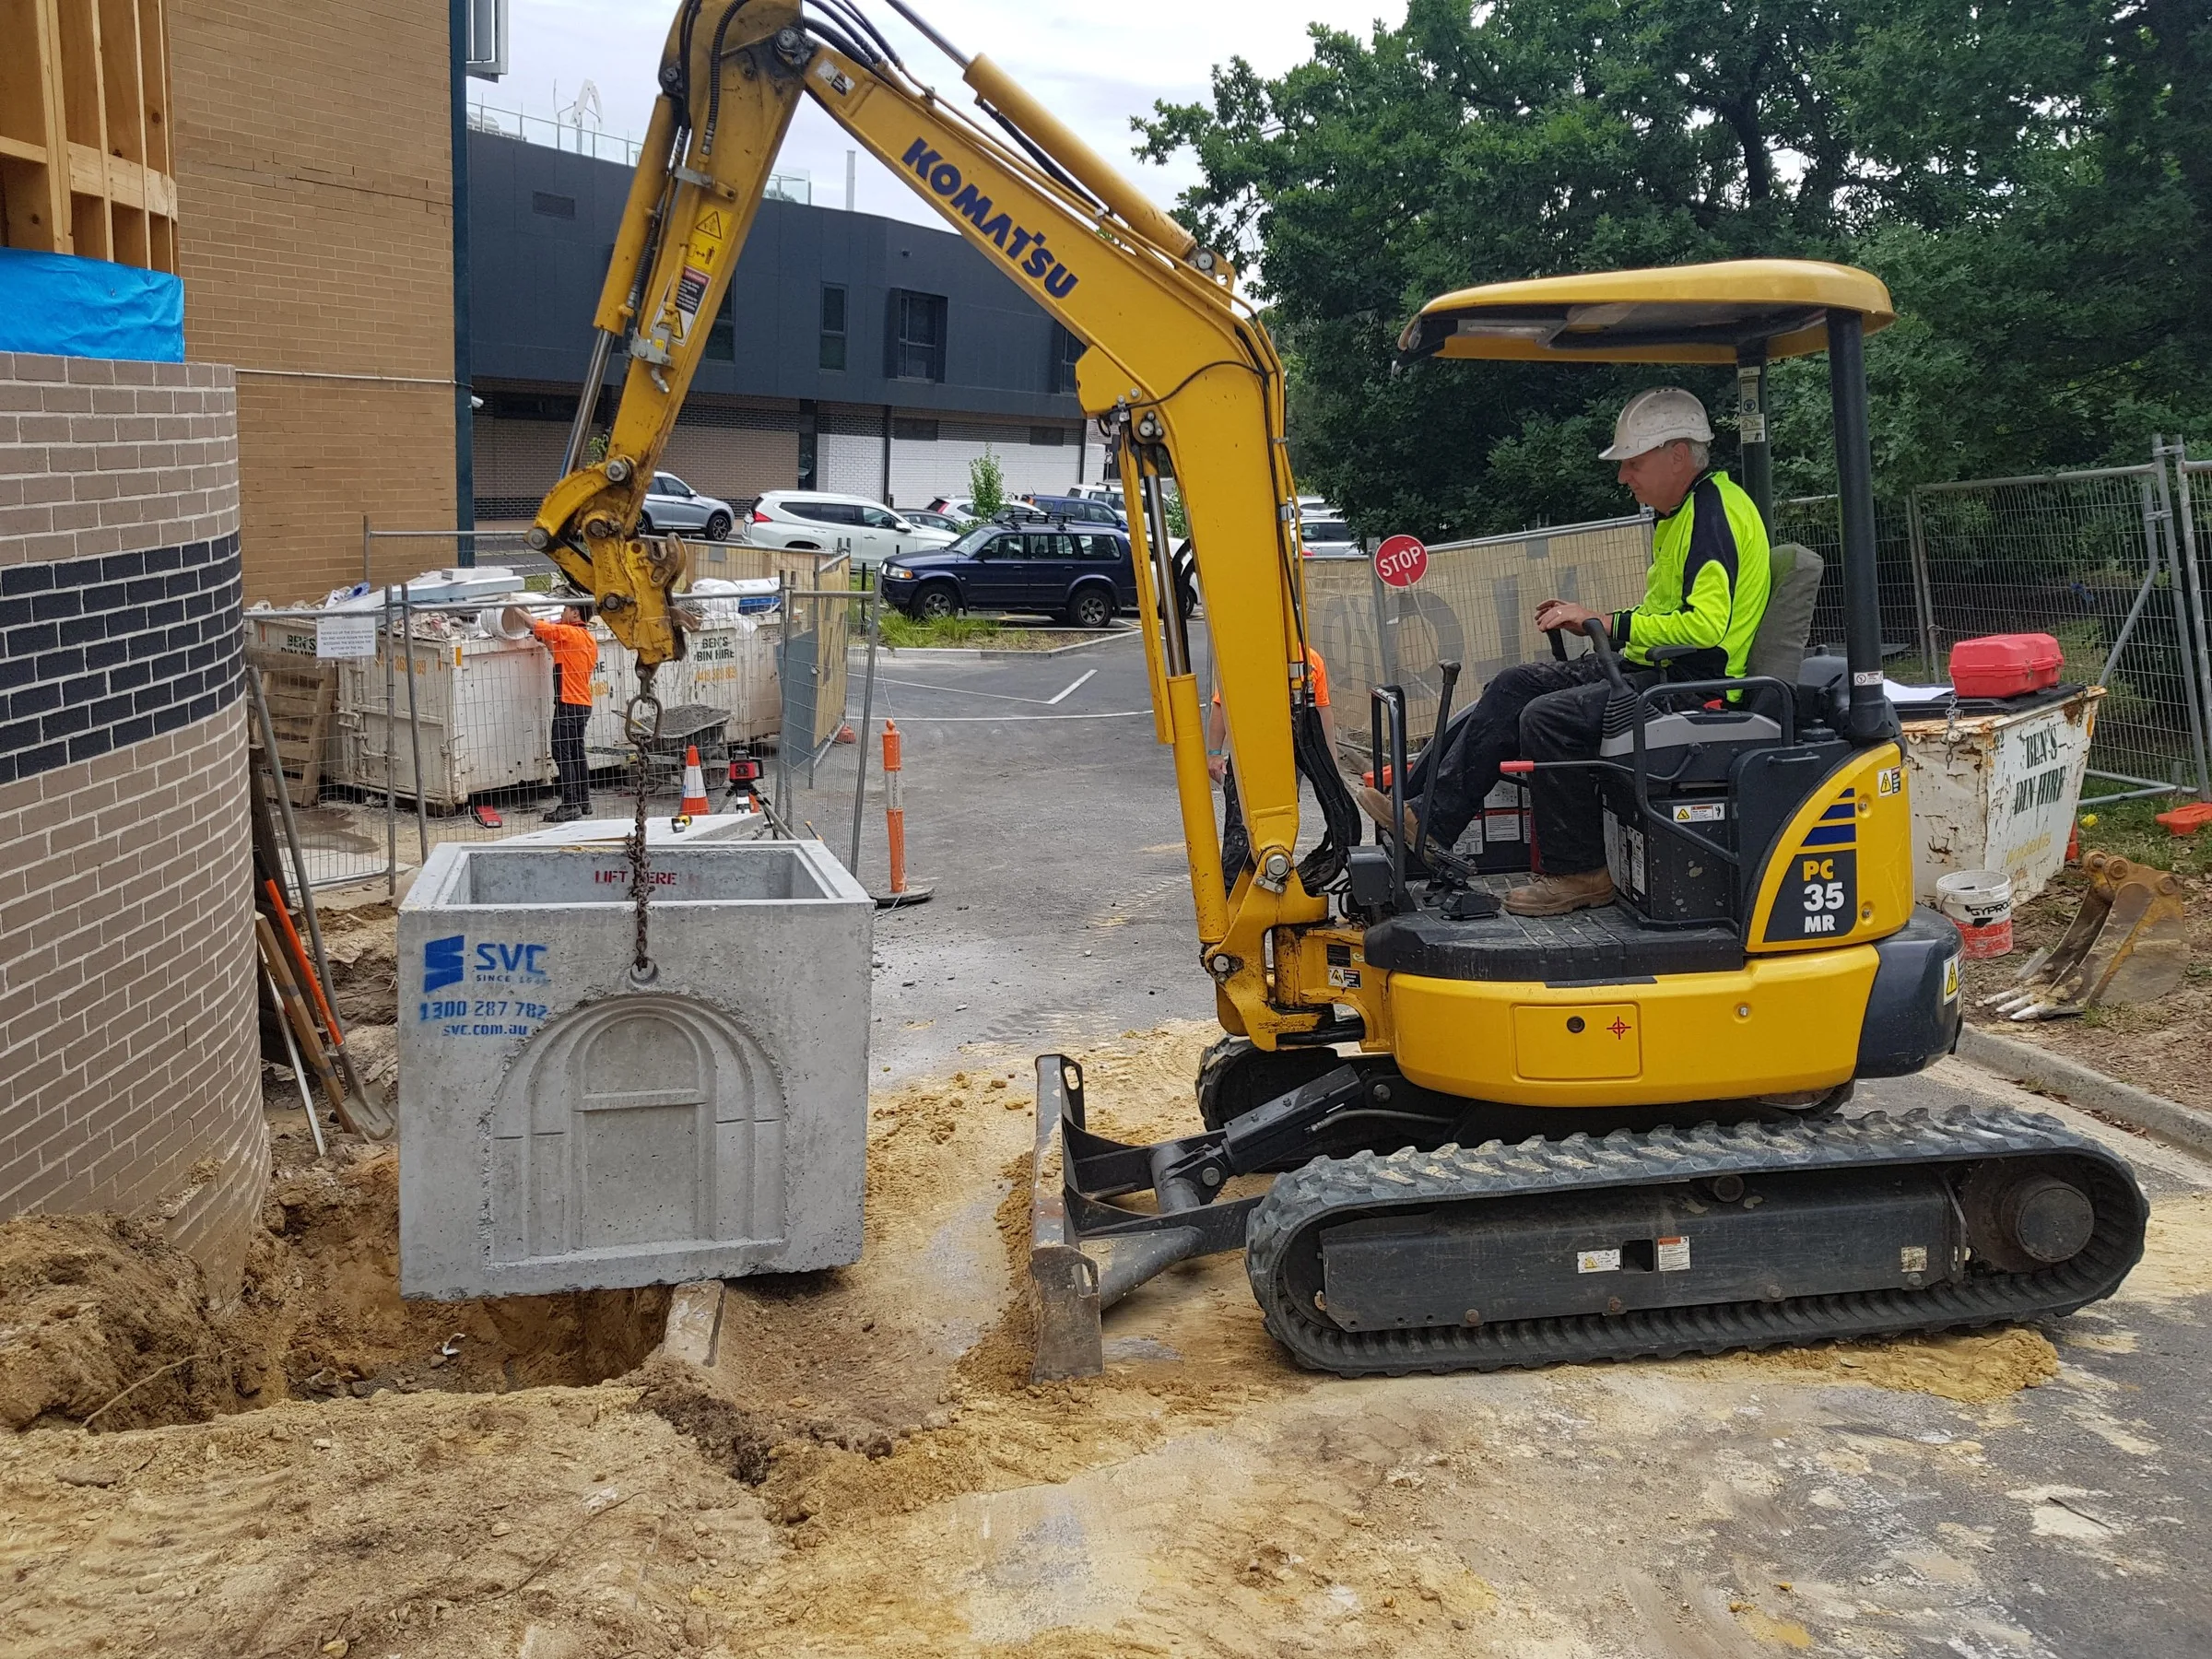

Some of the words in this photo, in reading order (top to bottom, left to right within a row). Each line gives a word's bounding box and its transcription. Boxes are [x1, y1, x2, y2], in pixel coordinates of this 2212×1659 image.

[901, 136, 1079, 299] KOMATSU
[1380, 546, 1421, 577] STOP
[702, 636, 729, 649] BEN'S
[697, 650, 712, 662] BIN
[715, 648, 735, 660] HIRE
[2025, 728, 2058, 769] BEN'S
[2013, 776, 2036, 815] BIN
[2036, 765, 2067, 806] HIRE
[594, 870, 629, 883] LIFT
[645, 871, 677, 886] ERE
[1803, 858, 1834, 881] PC
[1803, 882, 1845, 912] 35
[1970, 901, 2011, 916] GYPRO
[1804, 914, 1836, 933] MR
[474, 943, 547, 975] SVC
[476, 974, 512, 982] SINCE
[419, 1001, 467, 1021] 1300
[475, 1001, 508, 1016] 287
[515, 1001, 547, 1020] 782
[442, 1024, 528, 1036] svc.com.au
